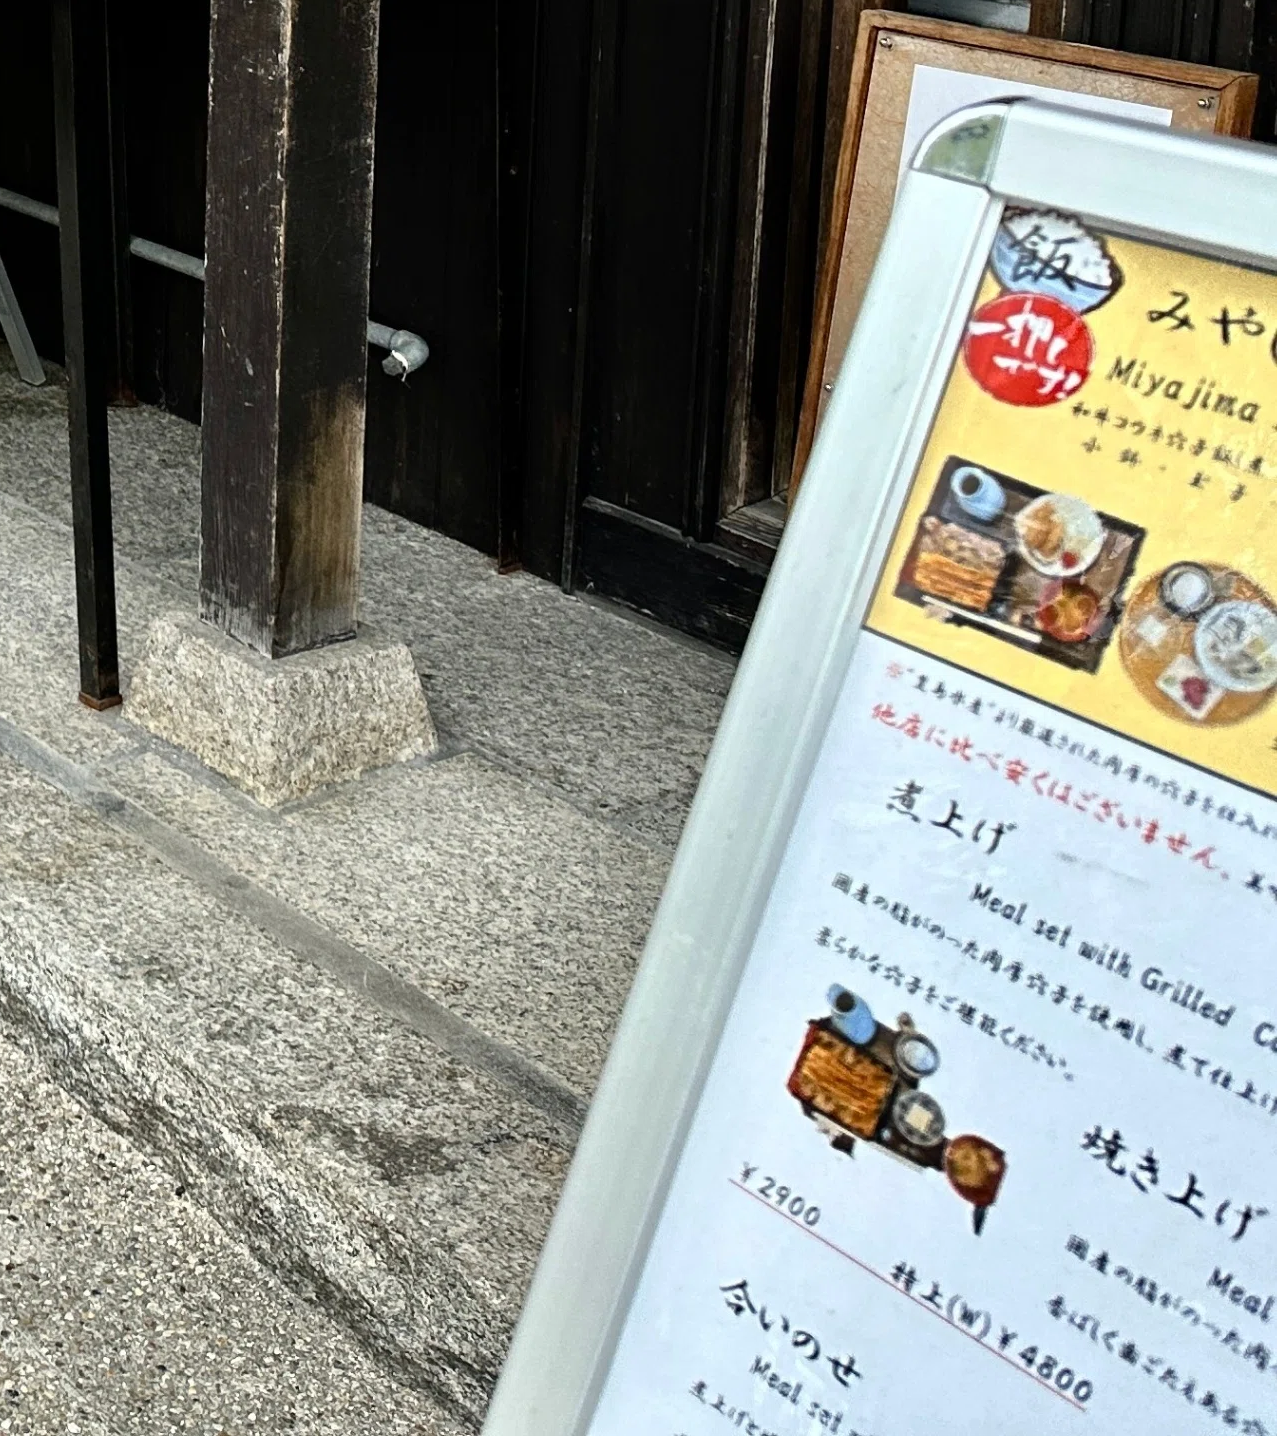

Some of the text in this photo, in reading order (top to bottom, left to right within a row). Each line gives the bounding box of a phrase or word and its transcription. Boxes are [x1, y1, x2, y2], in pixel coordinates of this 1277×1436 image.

[1104, 355, 1261, 424] Miyajima
[886, 777, 1019, 857] 煮上げ
[969, 880, 1029, 927] Meal
[1033, 916, 1073, 949] set
[1077, 938, 1133, 981] with
[1139, 966, 1237, 1029] Grilled
[1079, 1124, 1270, 1243] 焼き上げ
[1207, 1266, 1276, 1323] Meal
[748, 1354, 803, 1406] Meal
